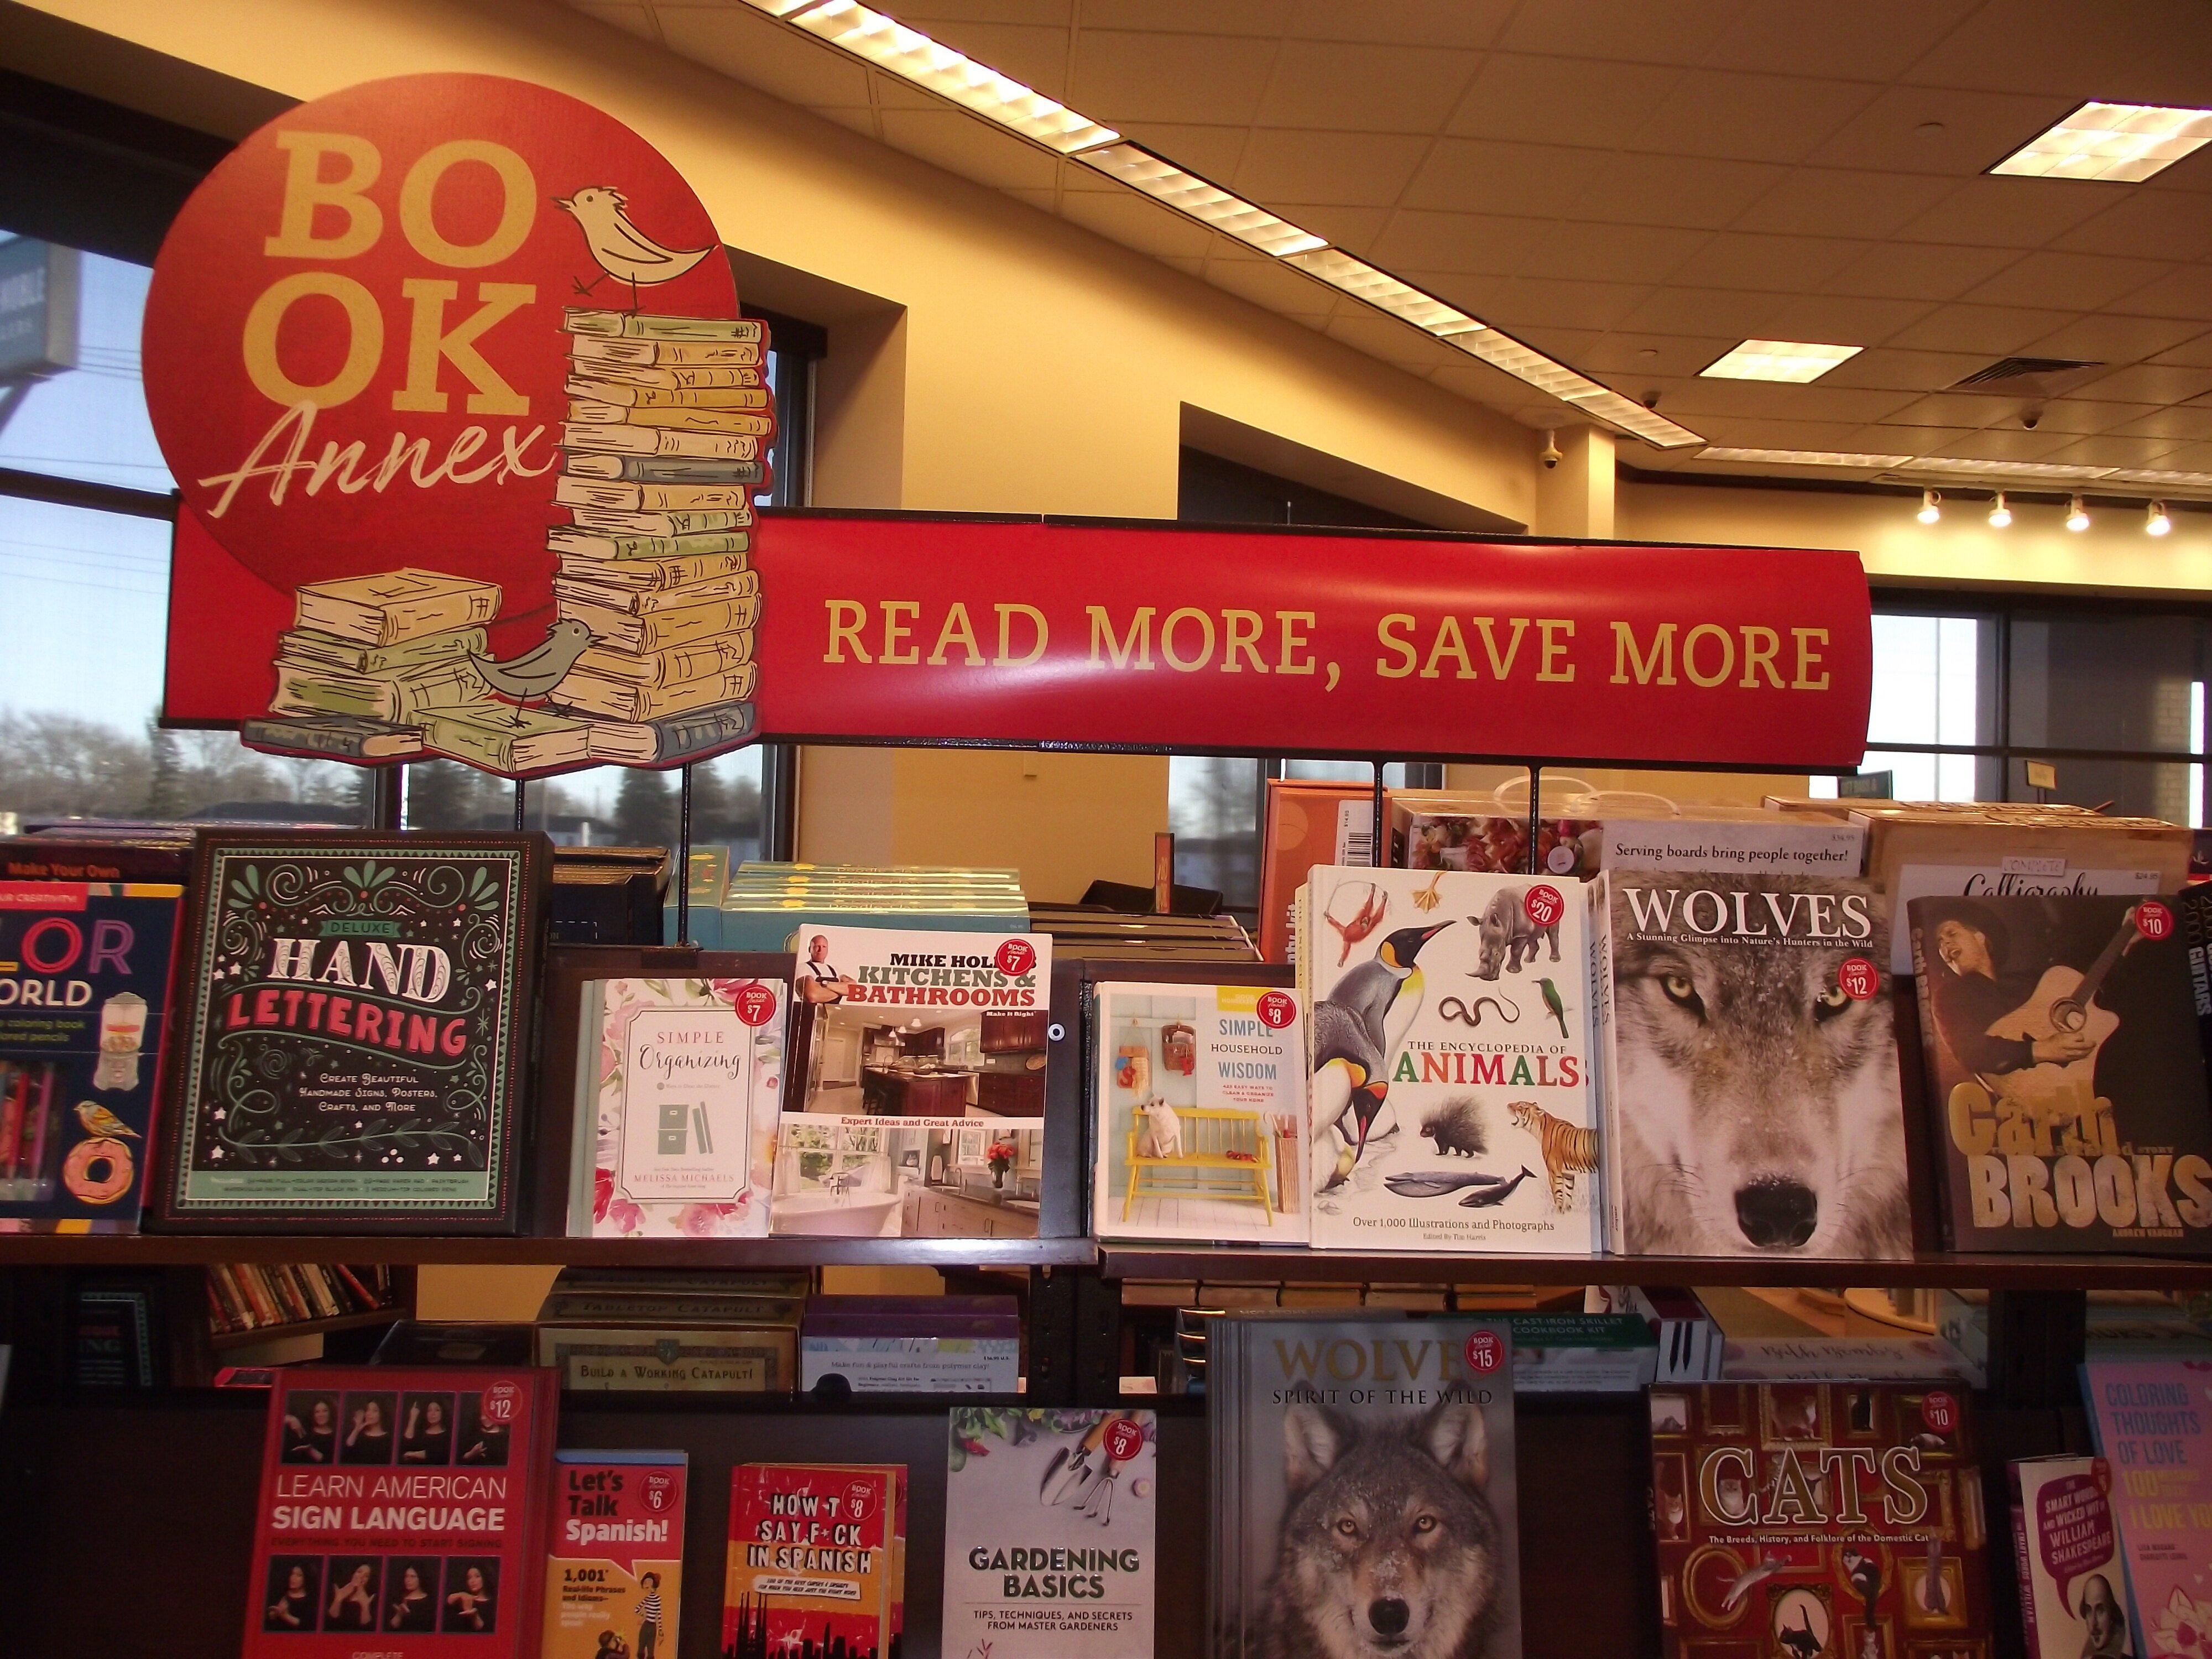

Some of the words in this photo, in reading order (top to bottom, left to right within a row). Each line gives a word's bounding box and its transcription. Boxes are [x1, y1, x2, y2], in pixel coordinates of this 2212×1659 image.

[264, 129, 537, 268] BO
[243, 271, 536, 416] OK
[197, 401, 556, 518] Annex
[823, 599, 1049, 667] READ
[1085, 606, 1340, 692] MORE,
[1376, 613, 1575, 683] SAVE
[1609, 621, 1830, 691] MORE
[1615, 843, 1662, 859] Serving
[1667, 844, 1708, 858] boards
[1712, 846, 1745, 862] bring
[1749, 847, 1789, 863] people
[1793, 849, 1848, 864] together!
[7, 862, 49, 875] Make
[50, 863, 83, 877] Your
[1539, 889, 1559, 903] BOOK
[1531, 899, 1552, 922] $20
[1623, 888, 1871, 938] WOLVES
[2142, 906, 2163, 914] BOOK
[331, 922, 392, 934] DELUXE
[2142, 918, 2162, 935] $10
[1008, 943, 1028, 952] BOOK
[1636, 933, 1677, 943] Stunning
[1681, 933, 1718, 945] Glimpse
[1721, 935, 1738, 944] into
[1742, 936, 1780, 945] Nature's
[1783, 938, 1820, 946] Hunters
[1835, 939, 1849, 947] the
[1852, 940, 1873, 948] Wild
[267, 938, 452, 1004] HAND
[1007, 956, 1021, 971] $7
[858, 966, 1008, 988] KITCHENS
[1015, 973, 1036, 988] &
[1600, 934, 1610, 1025] WOLVES
[1846, 977, 1867, 994] $12
[846, 984, 1036, 1006] BATHROOMS
[1267, 996, 1287, 1005] BOOK
[747, 1005, 761, 1022] $7
[1269, 1008, 1281, 1024] $8
[226, 989, 468, 1058] LETTERING
[657, 1031, 724, 1044] SIMPLE
[1211, 1044, 1283, 1055] HOUSEHOLD
[1408, 1041, 1434, 1050] THE
[1440, 1042, 1544, 1053] ENCYCLOPEDIA
[1549, 1045, 1567, 1055] OF
[639, 1044, 741, 1079] Organizing
[1218, 1061, 1277, 1080] WISDOM
[1392, 1051, 1580, 1088] ANIMALS
[841, 1117, 872, 1126] Expert
[1948, 1079, 2121, 1156] Garth
[634, 1174, 677, 1182] MELISSA
[682, 1174, 734, 1182] MICHAELS
[1967, 1154, 2212, 1228] BROOKS
[1353, 1217, 1377, 1227] Over
[1380, 1218, 1406, 1228] 1,000
[1410, 1218, 1469, 1229] Illustrations
[1472, 1219, 1490, 1229] and
[1493, 1219, 1555, 1232] Photographs
[873, 1362, 898, 1371] playful
[1473, 1349, 1493, 1368] $15
[581, 1365, 614, 1378] BUILD
[634, 1366, 686, 1379] WORKING
[1272, 1390, 1340, 1405] SPIRIT
[1349, 1390, 1376, 1404] OF
[1385, 1390, 1427, 1404] THE
[1436, 1390, 1492, 1405] WILD
[2106, 1383, 2190, 1407] COLORING
[490, 1399, 511, 1418] $12
[1929, 1408, 1948, 1426] $10
[1118, 1422, 1137, 1436] BOOK
[2110, 1411, 2201, 1435] THOUGHTS
[1114, 1436, 1126, 1454] $8
[2118, 1441, 2138, 1465] OF
[2142, 1440, 2188, 1464] LOVE
[276, 1475, 364, 1498] LEARN
[372, 1476, 507, 1499] AMERICAN
[568, 1470, 623, 1492] Let's
[649, 1476, 670, 1485] BOOK
[851, 1484, 872, 1494] BOOK
[1699, 1447, 1928, 1526] CATS
[568, 1495, 618, 1516] Talk
[649, 1490, 662, 1509] $6
[851, 1499, 863, 1518] $8
[272, 1505, 342, 1530] SIGN
[351, 1506, 505, 1531] LANGUAGE
[566, 1519, 668, 1546] Spanish!
[1709, 1535, 1724, 1544] The
[1726, 1535, 1757, 1544] Breeds,
[1759, 1536, 1792, 1545] History,
[1794, 1534, 1809, 1543] and
[1811, 1533, 1844, 1542] Folklore
[1847, 1533, 1856, 1542] of
[1858, 1533, 1871, 1542] the
[1874, 1533, 1913, 1542] Domestic
[1914, 1533, 1929, 1542] Cat
[2049, 1520, 2095, 1547] WILLIAM
[270, 1537, 340, 1546] EVERYTHING
[345, 1538, 365, 1547] YOU
[369, 1538, 397, 1547] NEED
[402, 1538, 415, 1547] TO
[419, 1539, 452, 1548] START
[456, 1540, 502, 1548] SIGNING
[2051, 1531, 2112, 1565] SHAKESPEARE
[750, 1545, 770, 1567] IN
[777, 1547, 872, 1574] SPANISH
[969, 1546, 1140, 1572] GARDENING
[1003, 1574, 1104, 1598] BASICS
[974, 1610, 996, 1620] TIPS,
[1000, 1611, 1064, 1620] TECHNIQUES,
[1067, 1611, 1089, 1620] AND
[1092, 1611, 1133, 1620] SECRETS
[987, 1621, 1015, 1630] FROM
[1019, 1621, 1057, 1630] MASTER
[1059, 1622, 1118, 1631] GARDENERS
